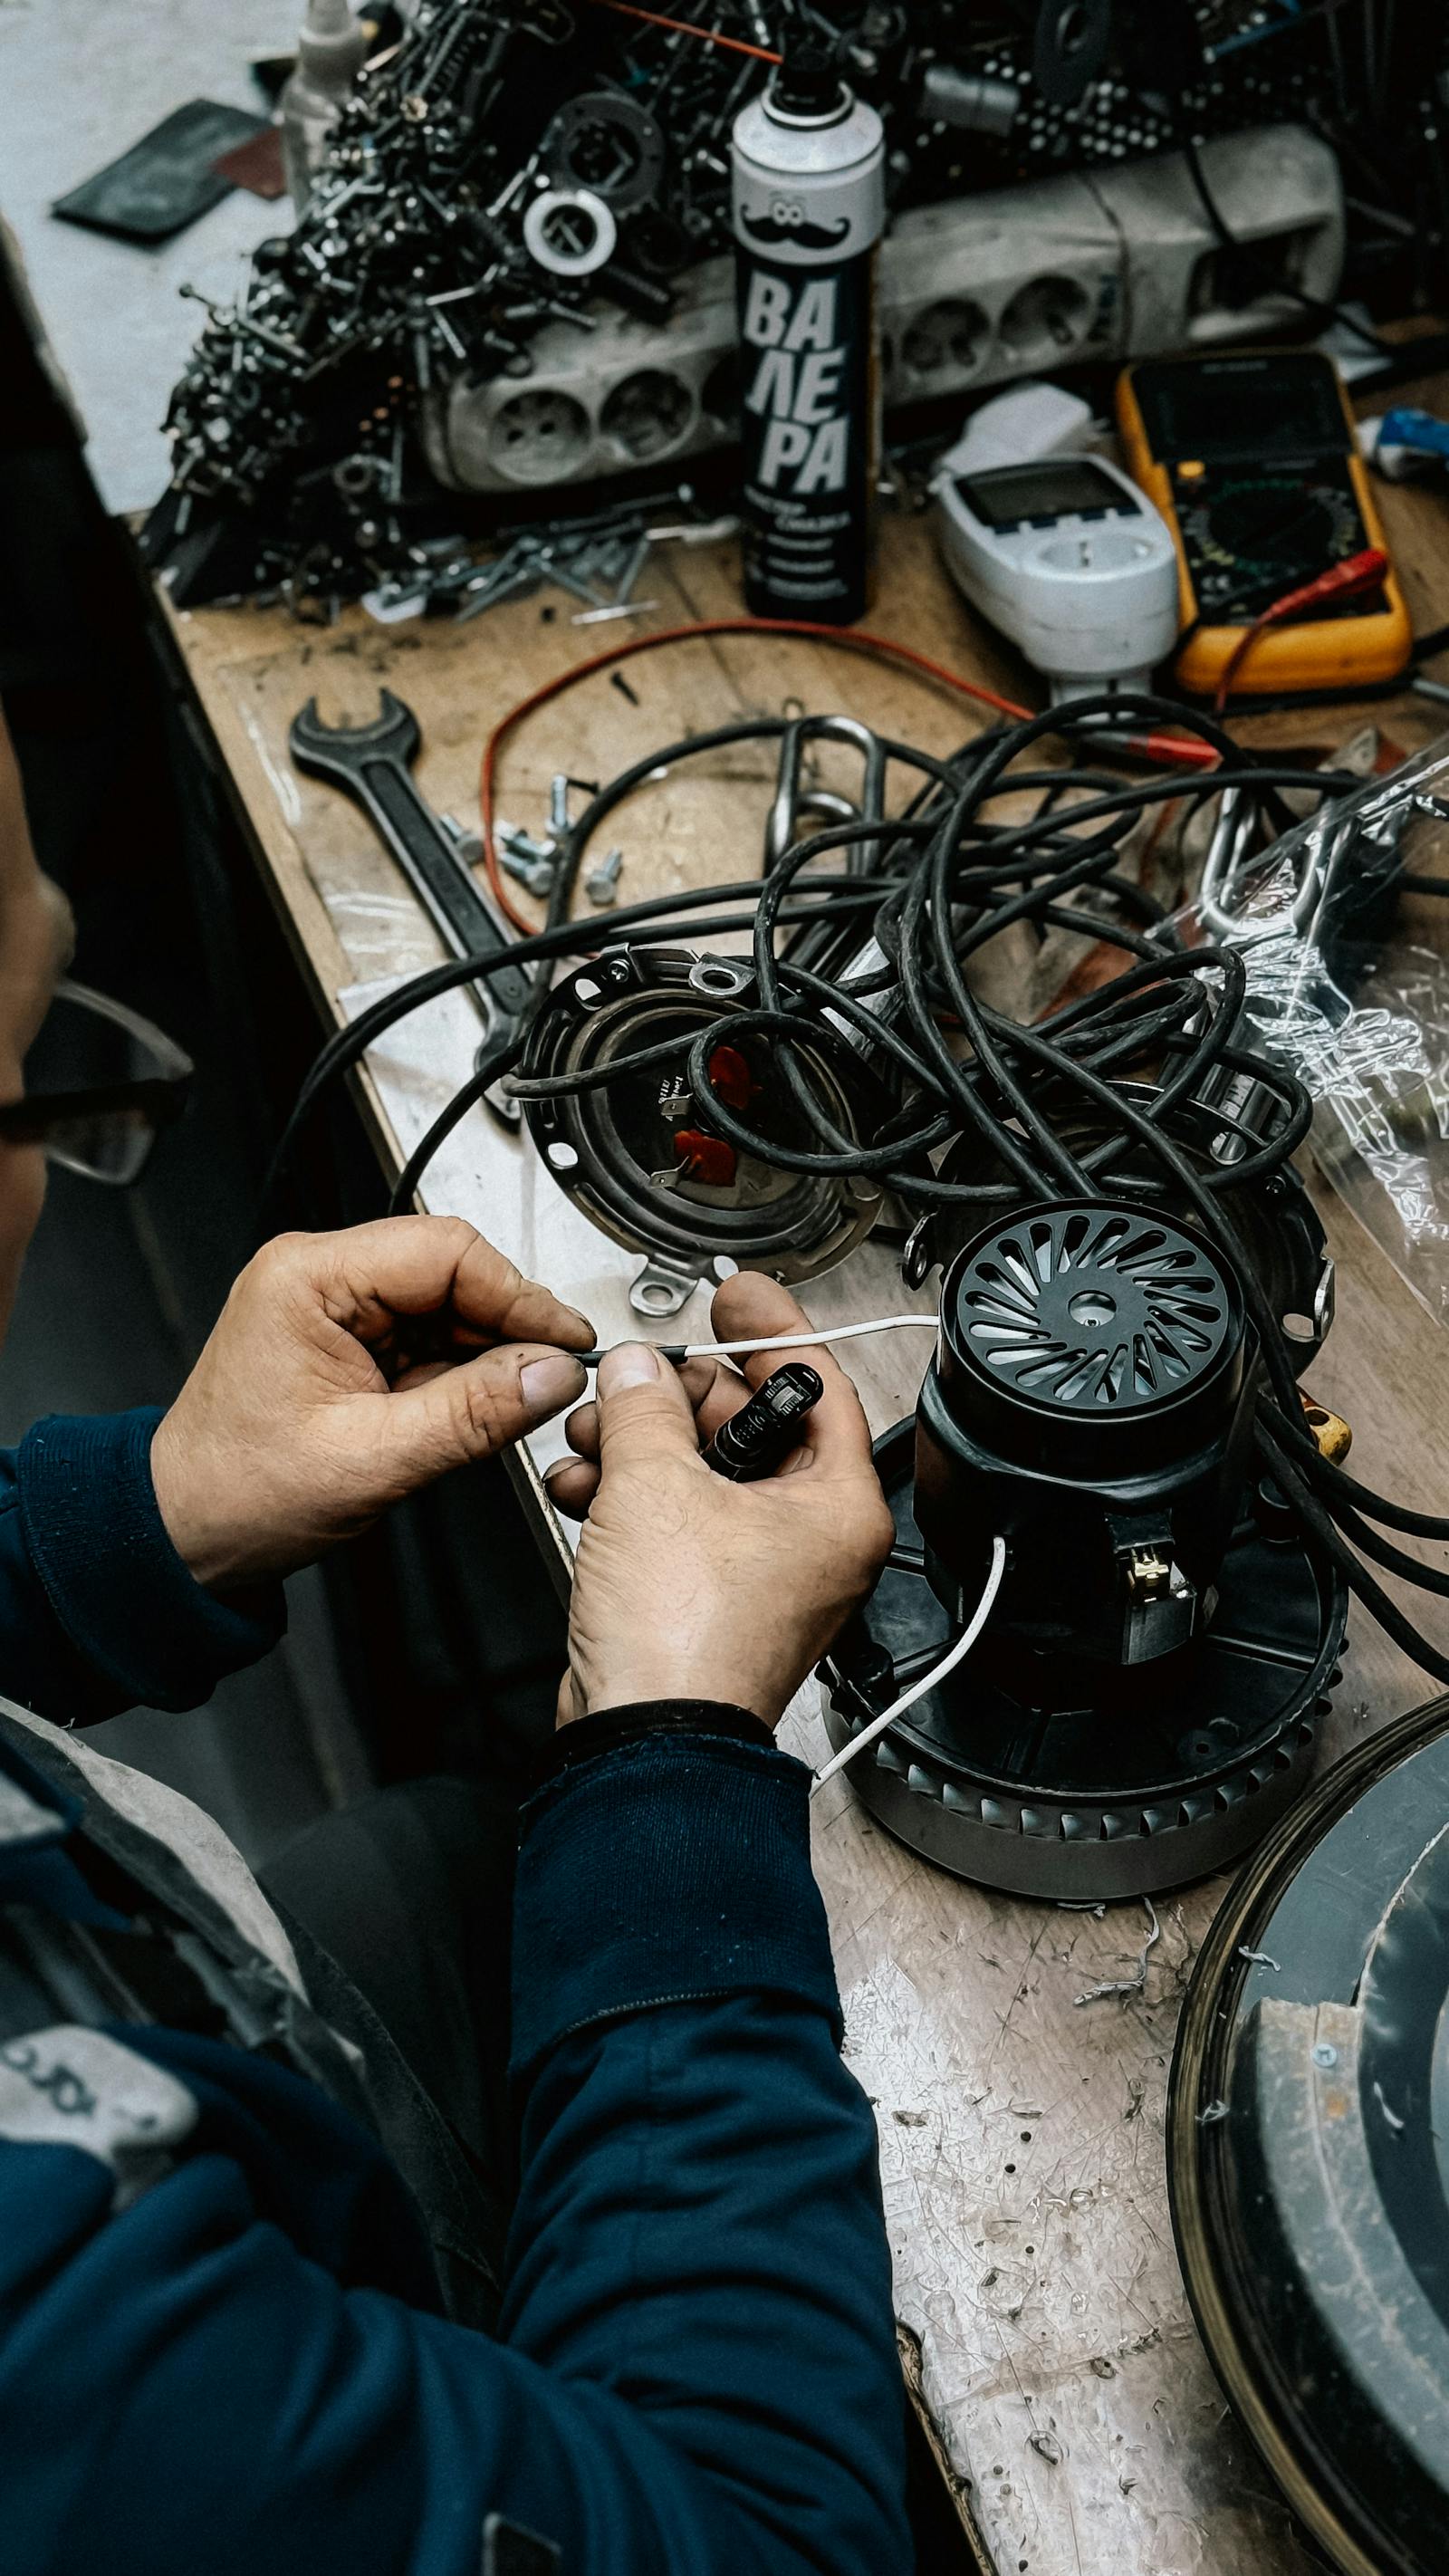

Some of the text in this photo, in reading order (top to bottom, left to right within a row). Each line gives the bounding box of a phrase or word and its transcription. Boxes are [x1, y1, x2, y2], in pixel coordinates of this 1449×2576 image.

[744, 270, 837, 351] ВА
[744, 346, 847, 424] ЛЕ
[758, 417, 849, 493] РА
